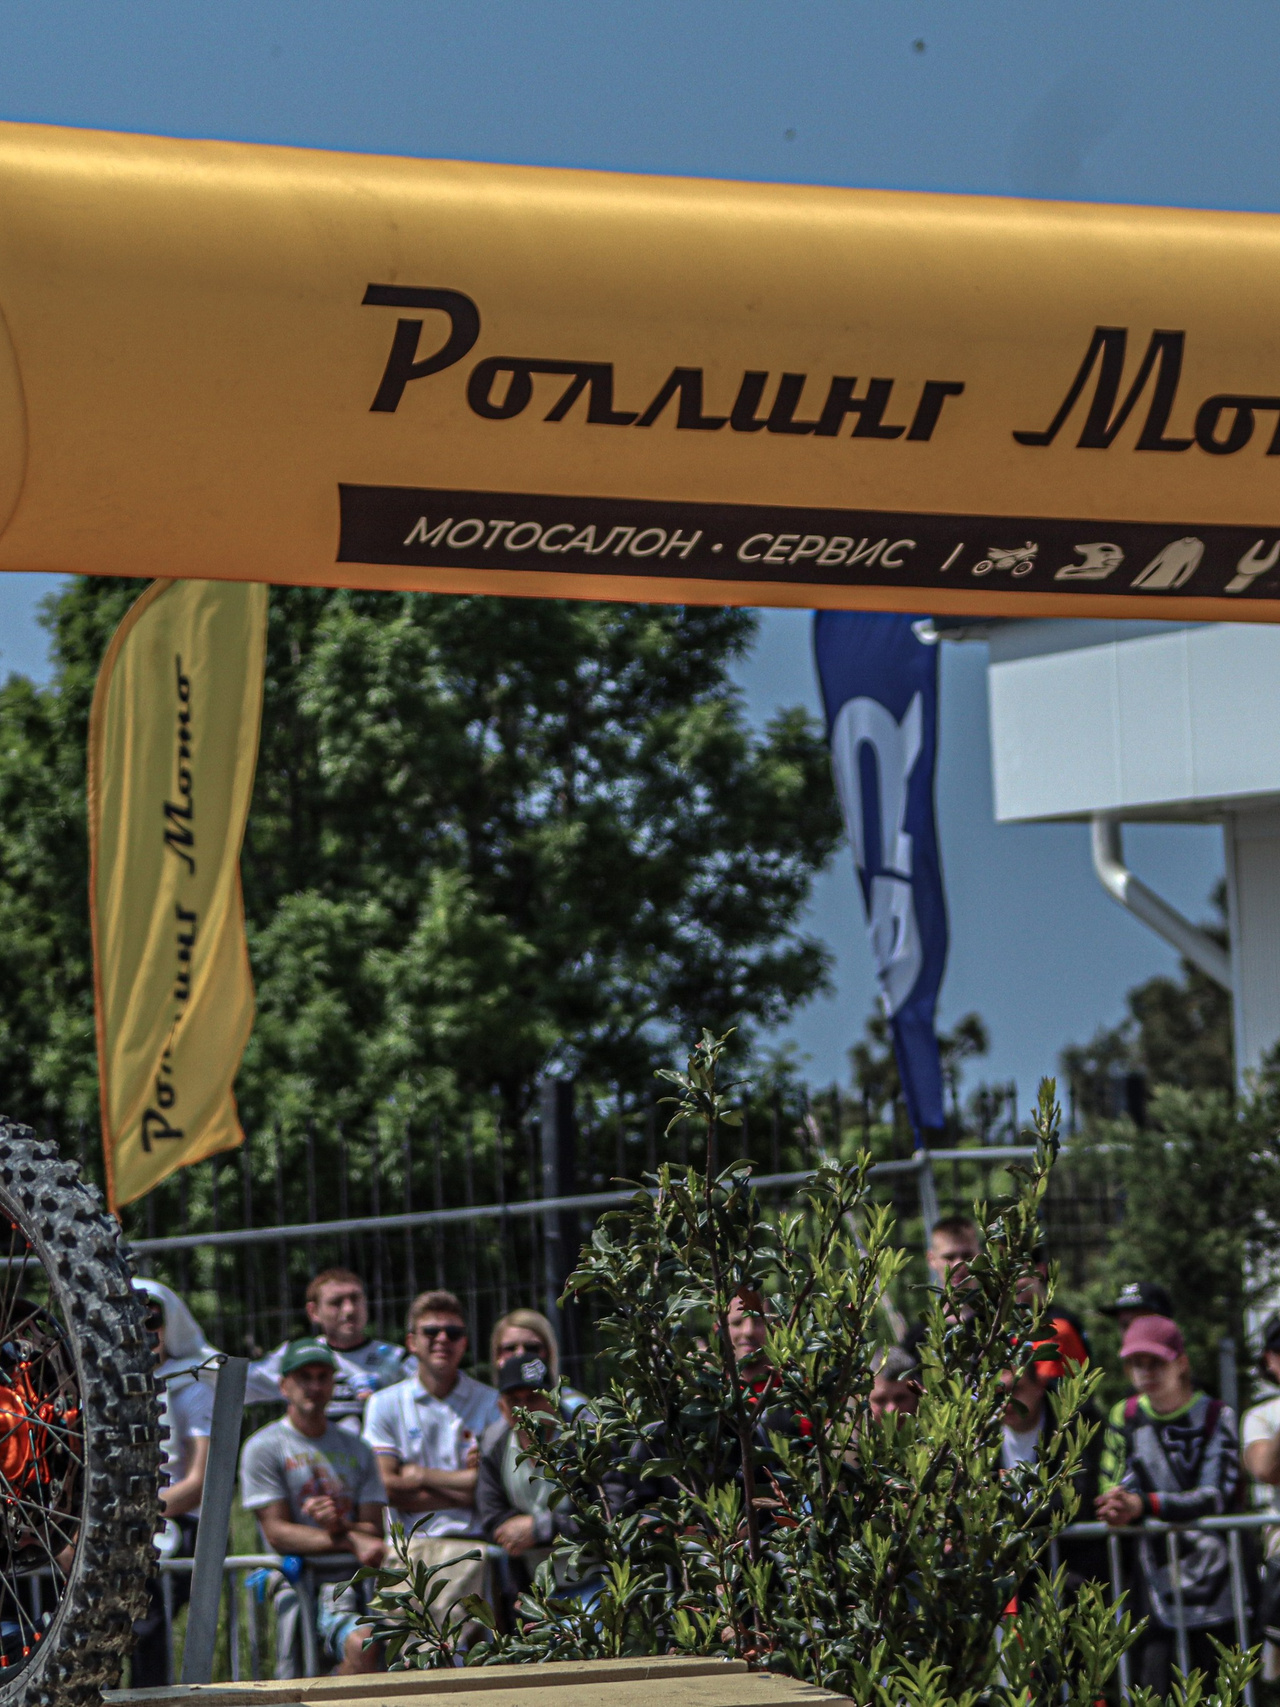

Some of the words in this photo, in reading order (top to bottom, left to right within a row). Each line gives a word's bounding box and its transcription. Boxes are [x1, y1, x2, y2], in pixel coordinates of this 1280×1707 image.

[361, 282, 966, 442] Роллинг
[403, 516, 703, 560] МОТОСАЛОН
[736, 532, 917, 569] СЕРВИС
